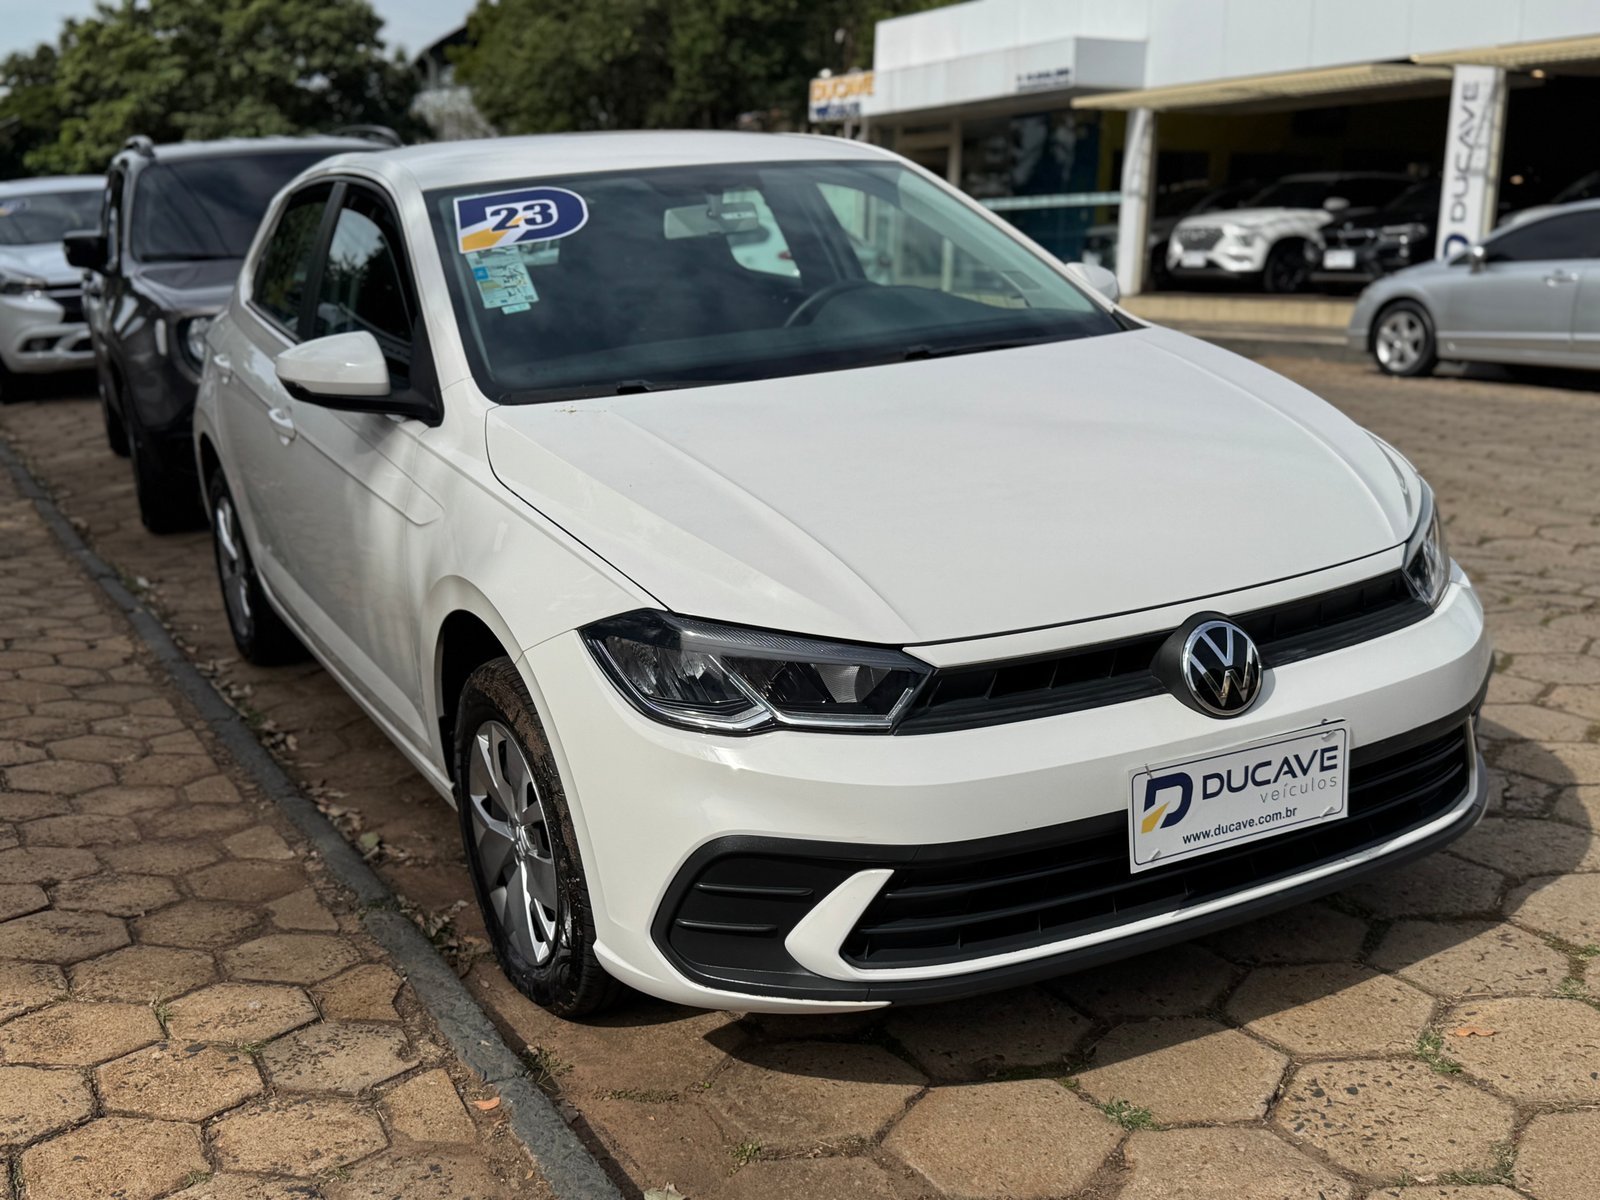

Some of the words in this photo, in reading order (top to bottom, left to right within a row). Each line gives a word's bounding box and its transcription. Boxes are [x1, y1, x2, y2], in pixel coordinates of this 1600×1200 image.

[1450, 82, 1479, 223] DUCAVE
[490, 203, 554, 232] 23
[1202, 745, 1338, 800] DUCAVE
[1260, 775, 1337, 803] veículos
[1182, 806, 1297, 844] www.ducave.com.br
